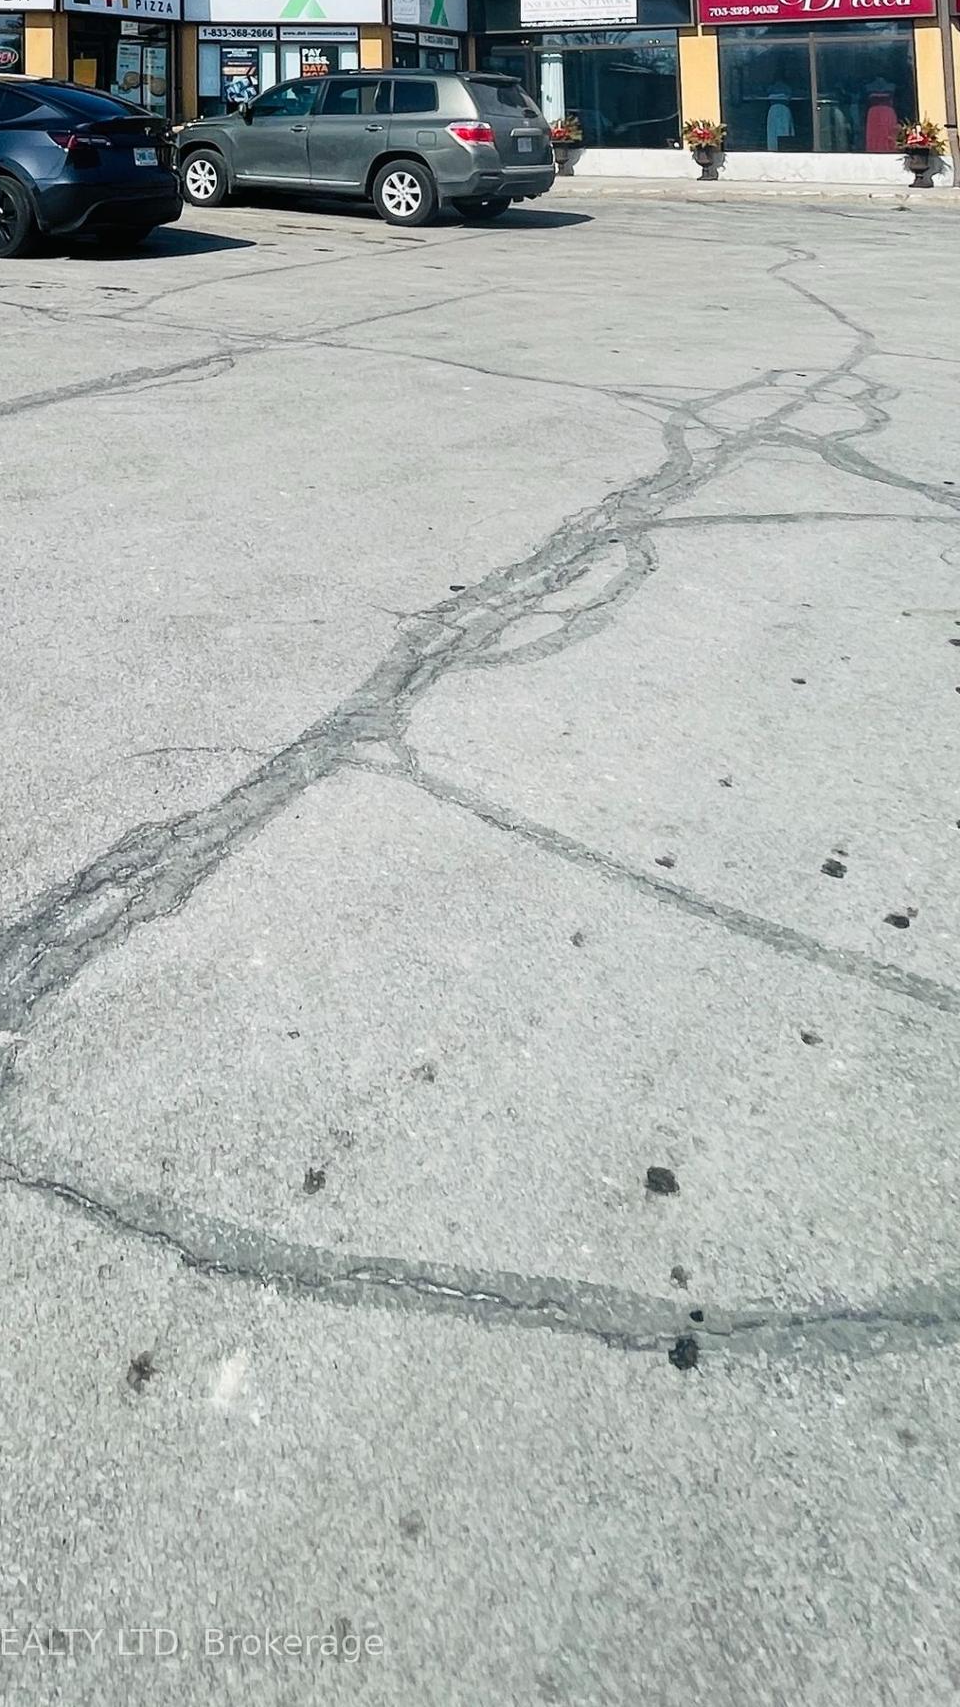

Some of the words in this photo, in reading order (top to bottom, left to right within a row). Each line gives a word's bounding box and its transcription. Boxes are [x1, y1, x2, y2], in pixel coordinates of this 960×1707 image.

[135, 0, 173, 13] PIZZA
[302, 48, 321, 57] PAY
[302, 64, 328, 72] DATA
